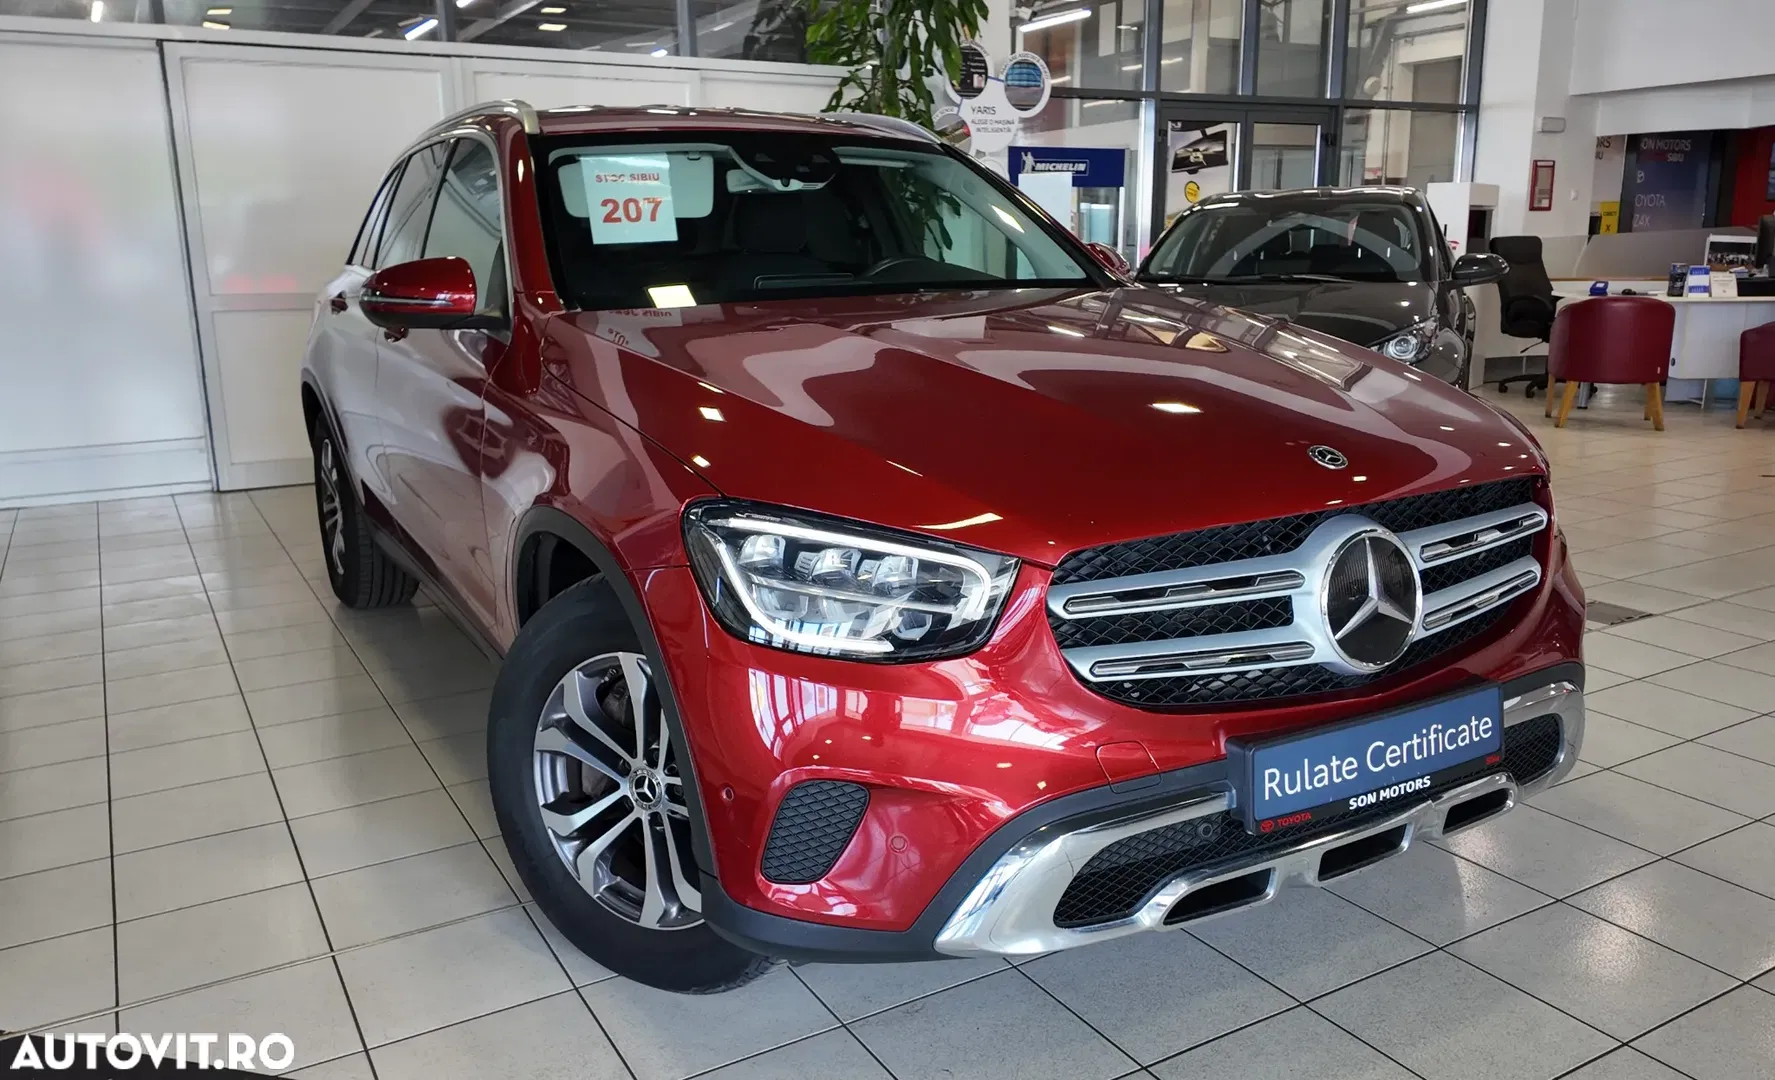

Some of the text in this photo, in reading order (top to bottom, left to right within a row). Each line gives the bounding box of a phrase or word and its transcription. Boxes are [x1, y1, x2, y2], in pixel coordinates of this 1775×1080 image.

[971, 105, 997, 115] YARIS
[1656, 139, 1692, 151] MOTORS
[1035, 162, 1087, 173] MICHELIN
[629, 172, 660, 182] SIBIU
[600, 197, 663, 224] 207
[1264, 715, 1493, 801] Rulate Certificate
[1348, 775, 1431, 810] SON MOTORS
[1276, 811, 1312, 826] TOYOTA
